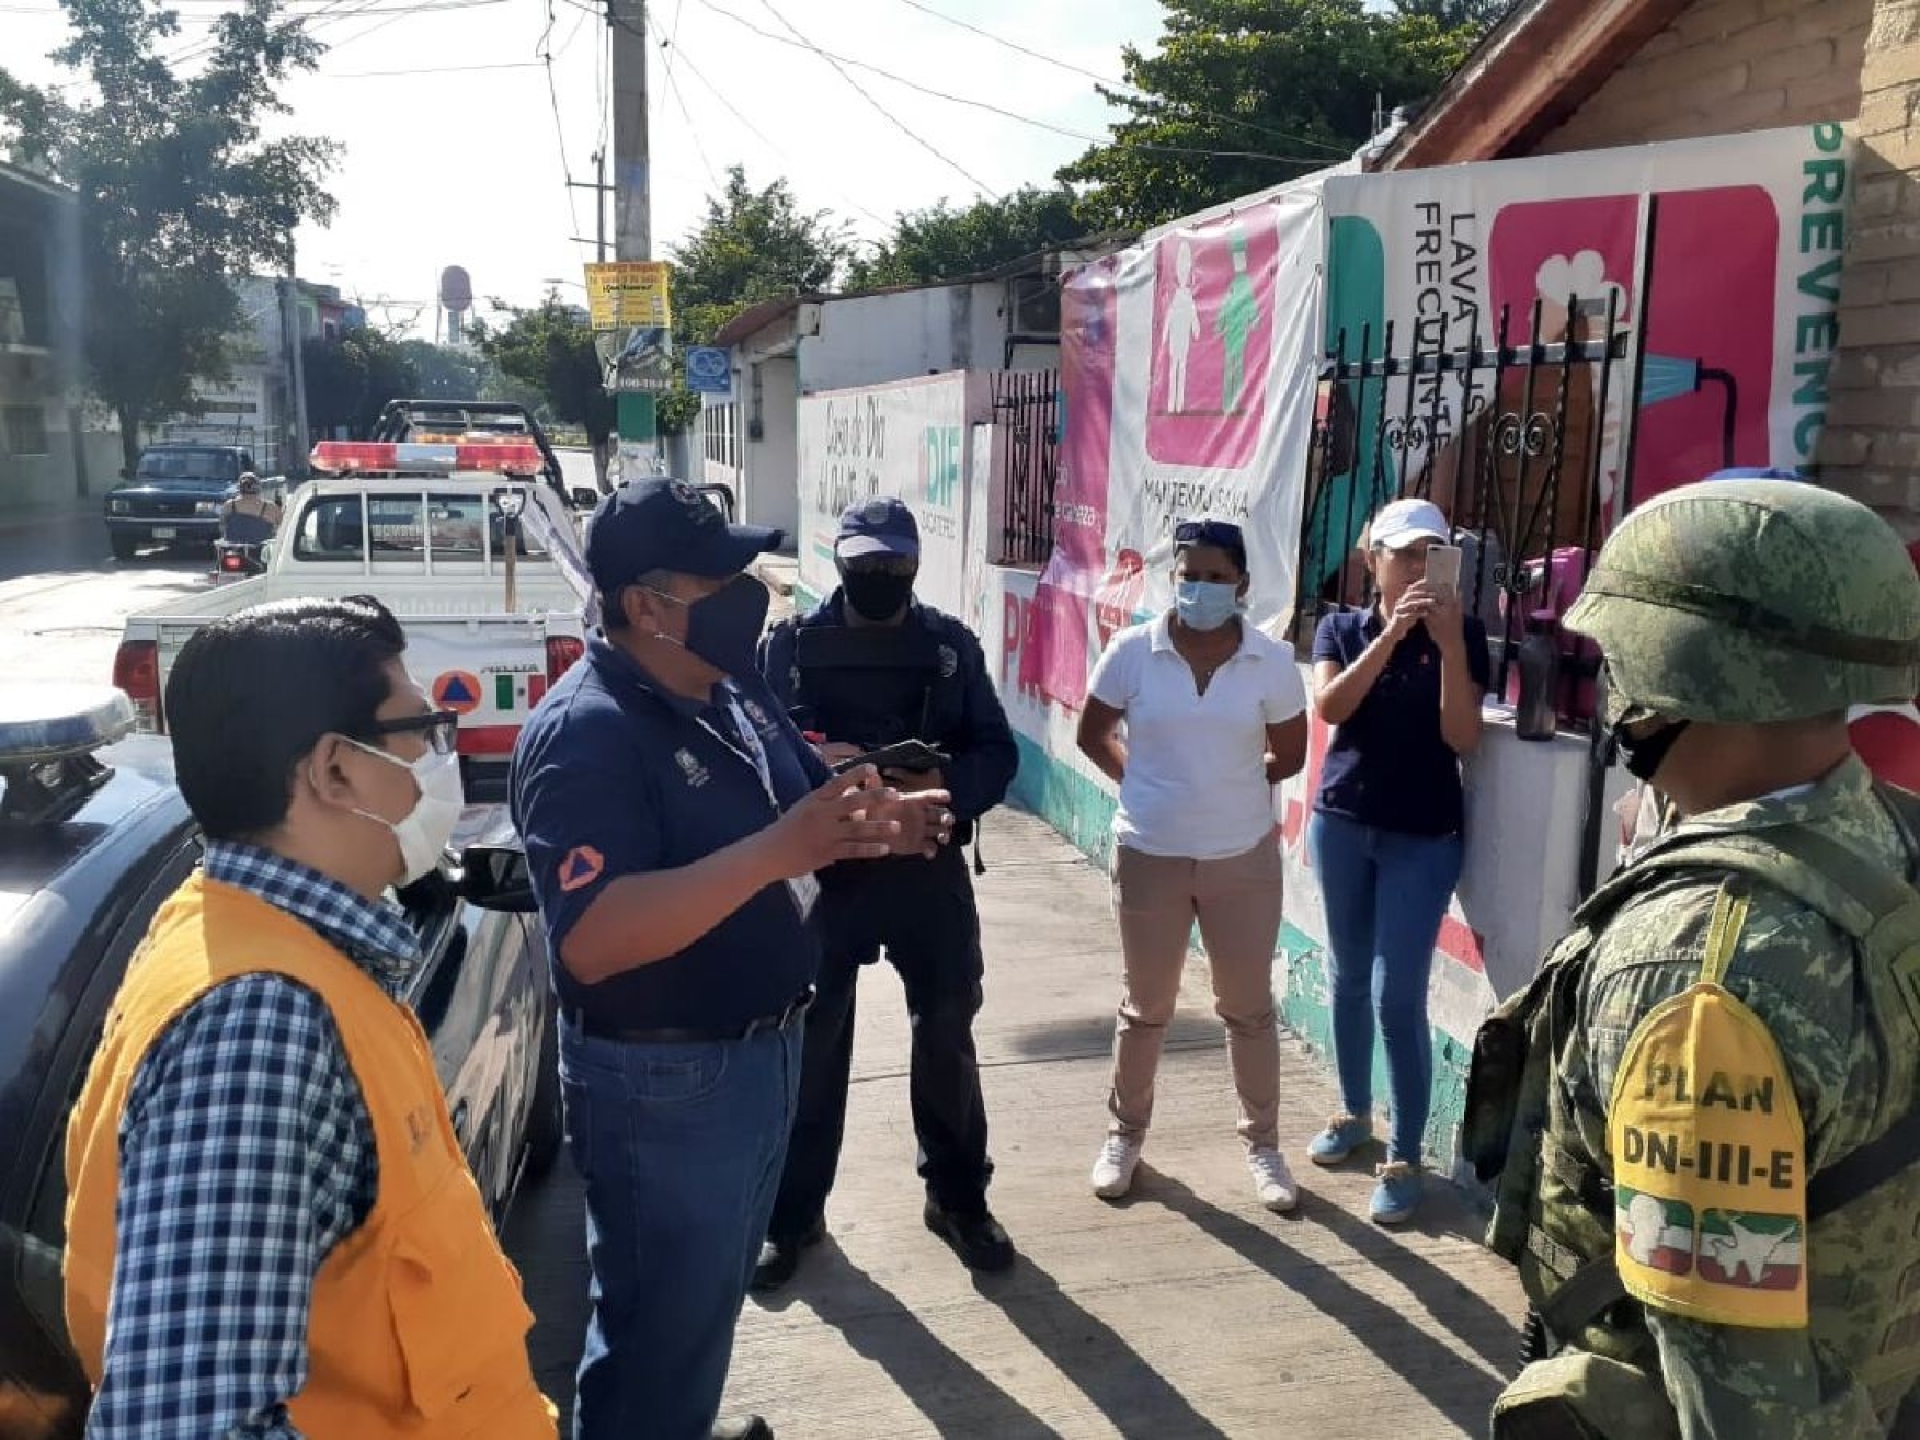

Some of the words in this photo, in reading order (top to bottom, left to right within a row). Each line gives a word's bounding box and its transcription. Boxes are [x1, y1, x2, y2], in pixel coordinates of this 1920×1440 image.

[1450, 213, 1478, 323] LAVA
[1795, 122, 1851, 476] PREVENC
[926, 426, 960, 507] DIF
[1644, 1062, 1773, 1114] PLAN
[1623, 1127, 1794, 1190] DN-III-E
